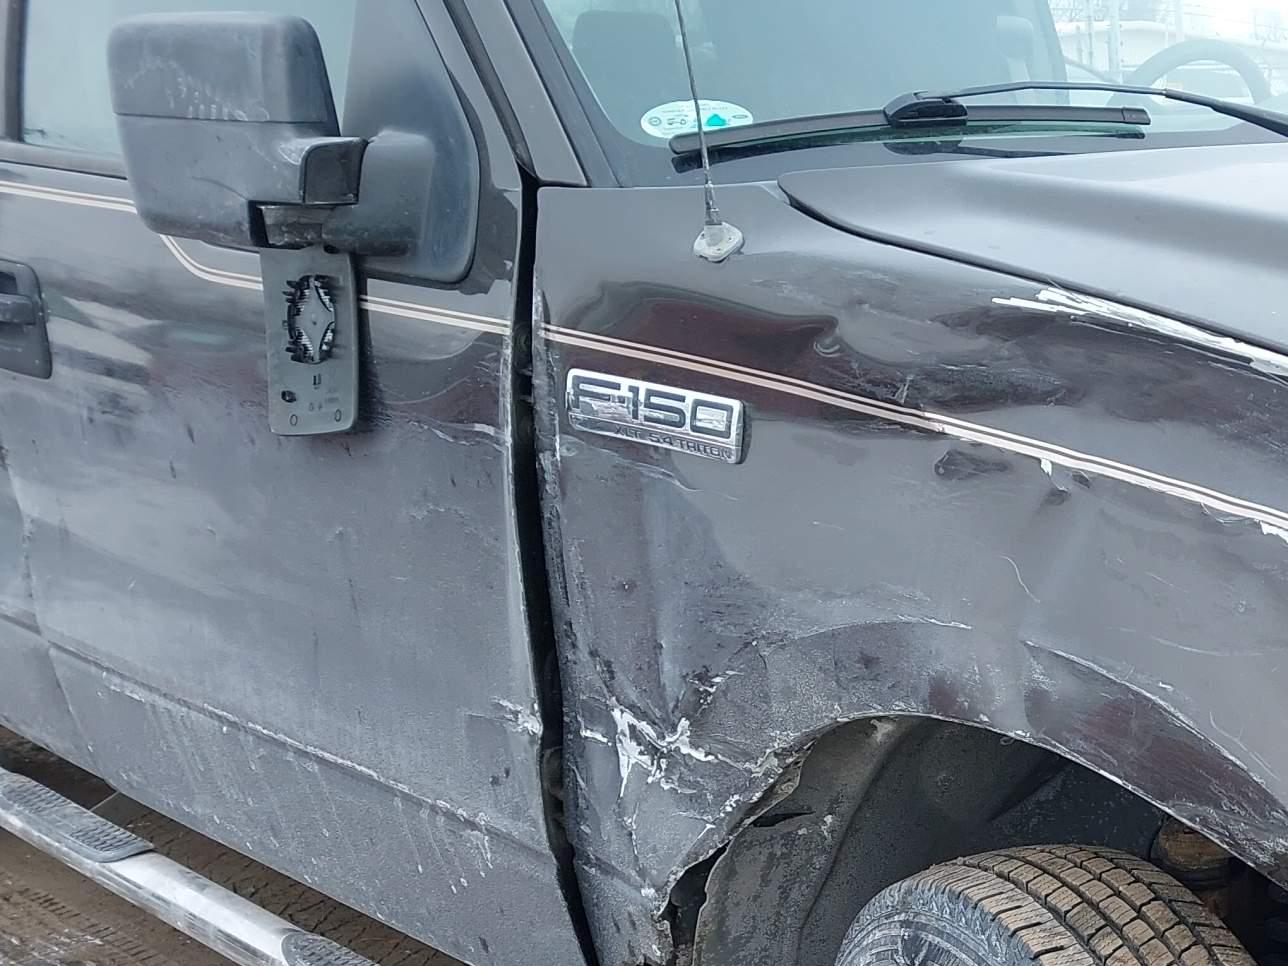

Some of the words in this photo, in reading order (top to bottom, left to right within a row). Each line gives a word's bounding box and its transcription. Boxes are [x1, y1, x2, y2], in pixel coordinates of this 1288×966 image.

[572, 374, 734, 440] F-150
[614, 425, 641, 439] XLT
[676, 439, 733, 459] TRITON
